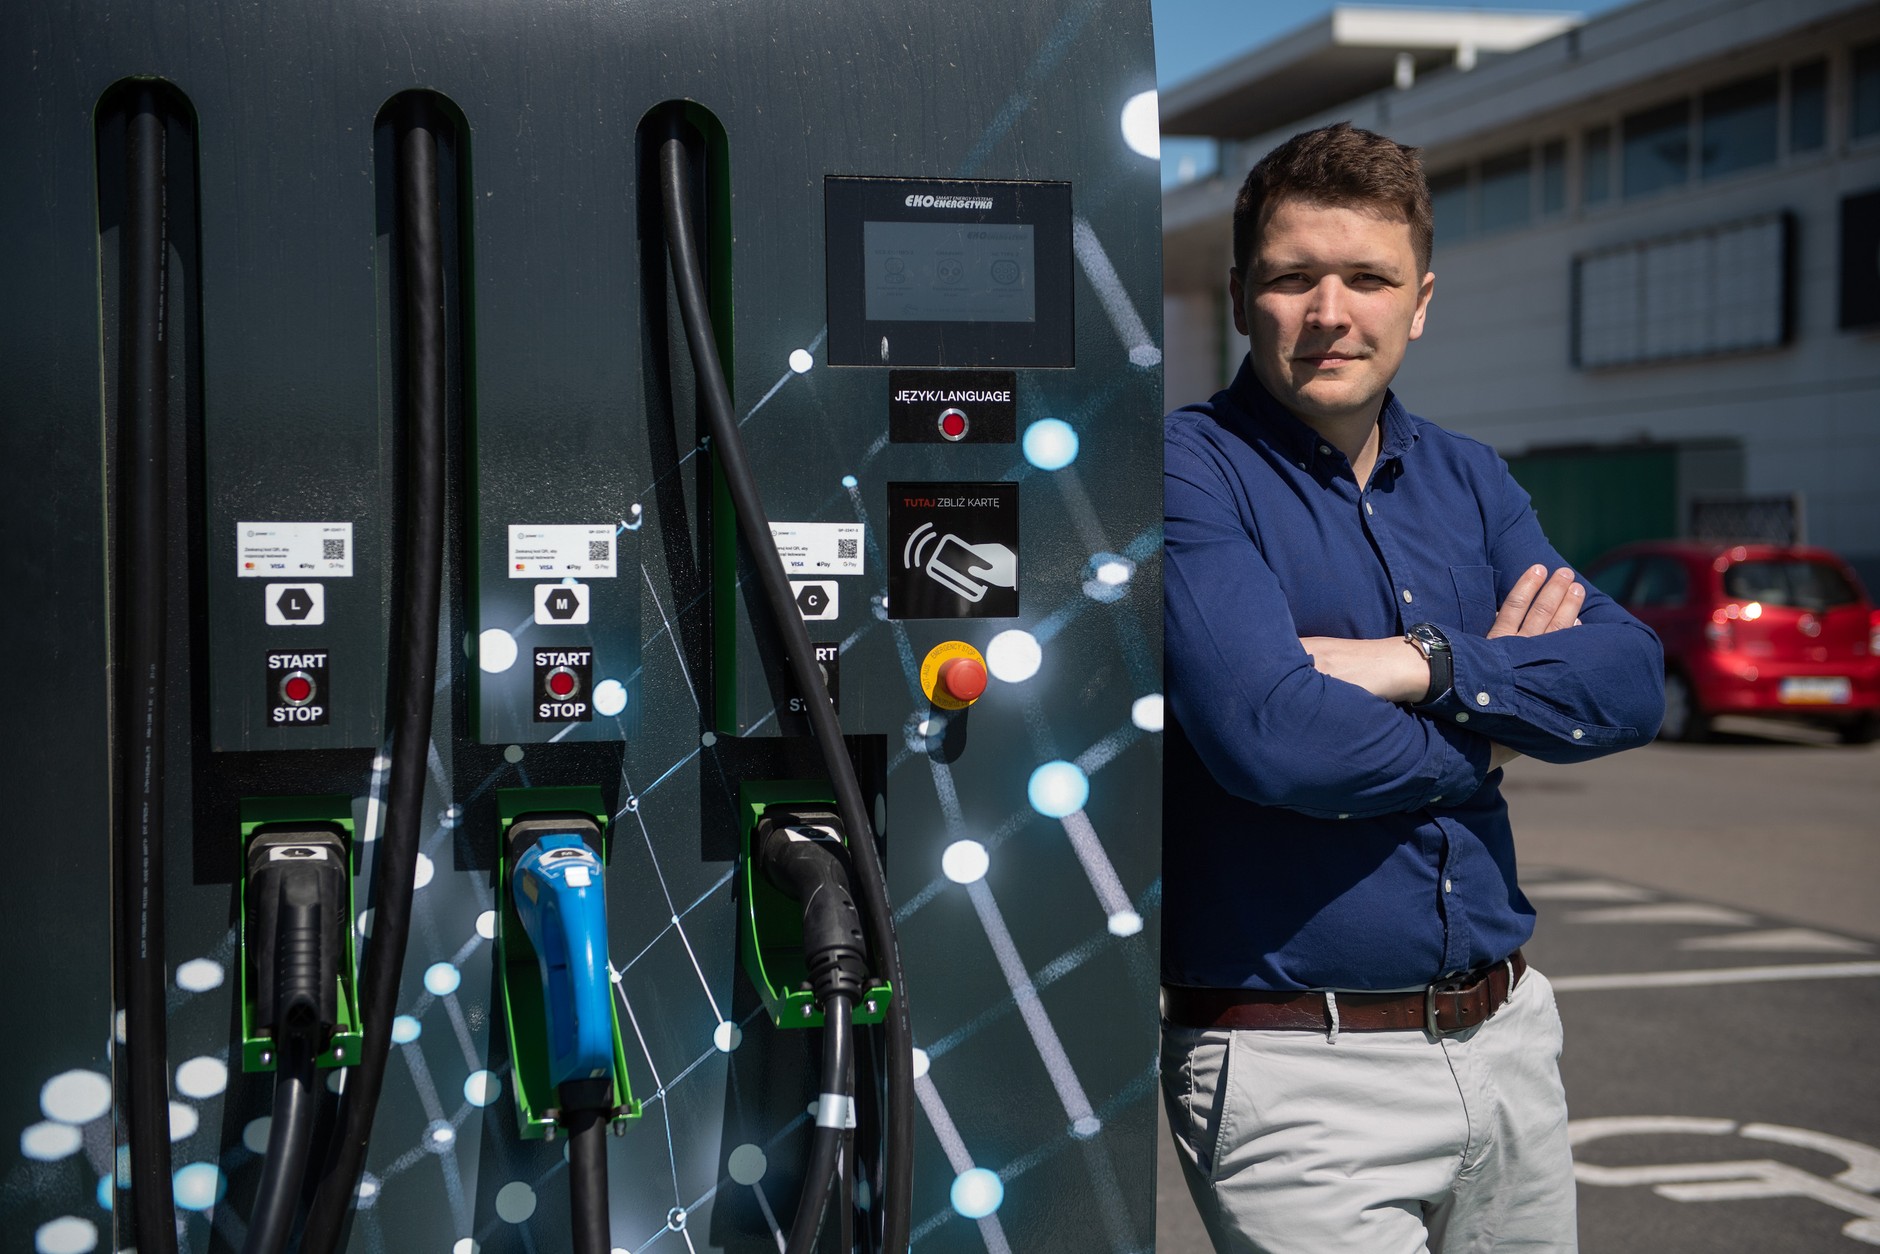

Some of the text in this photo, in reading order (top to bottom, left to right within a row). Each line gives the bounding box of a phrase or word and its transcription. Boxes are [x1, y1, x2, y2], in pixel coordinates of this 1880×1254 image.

[895, 391, 1011, 404] JĘZYK/LANGUAGE
[904, 496, 1000, 508] TUTAJ ZBLIŻ KARTĘ
[291, 599, 301, 610] L
[556, 599, 568, 610] M
[808, 595, 818, 606] C
[930, 642, 976, 659] EMERGENCY STOP
[268, 654, 327, 669] START
[535, 652, 591, 666] START
[273, 706, 323, 722] STOP
[539, 703, 586, 718] STOP
